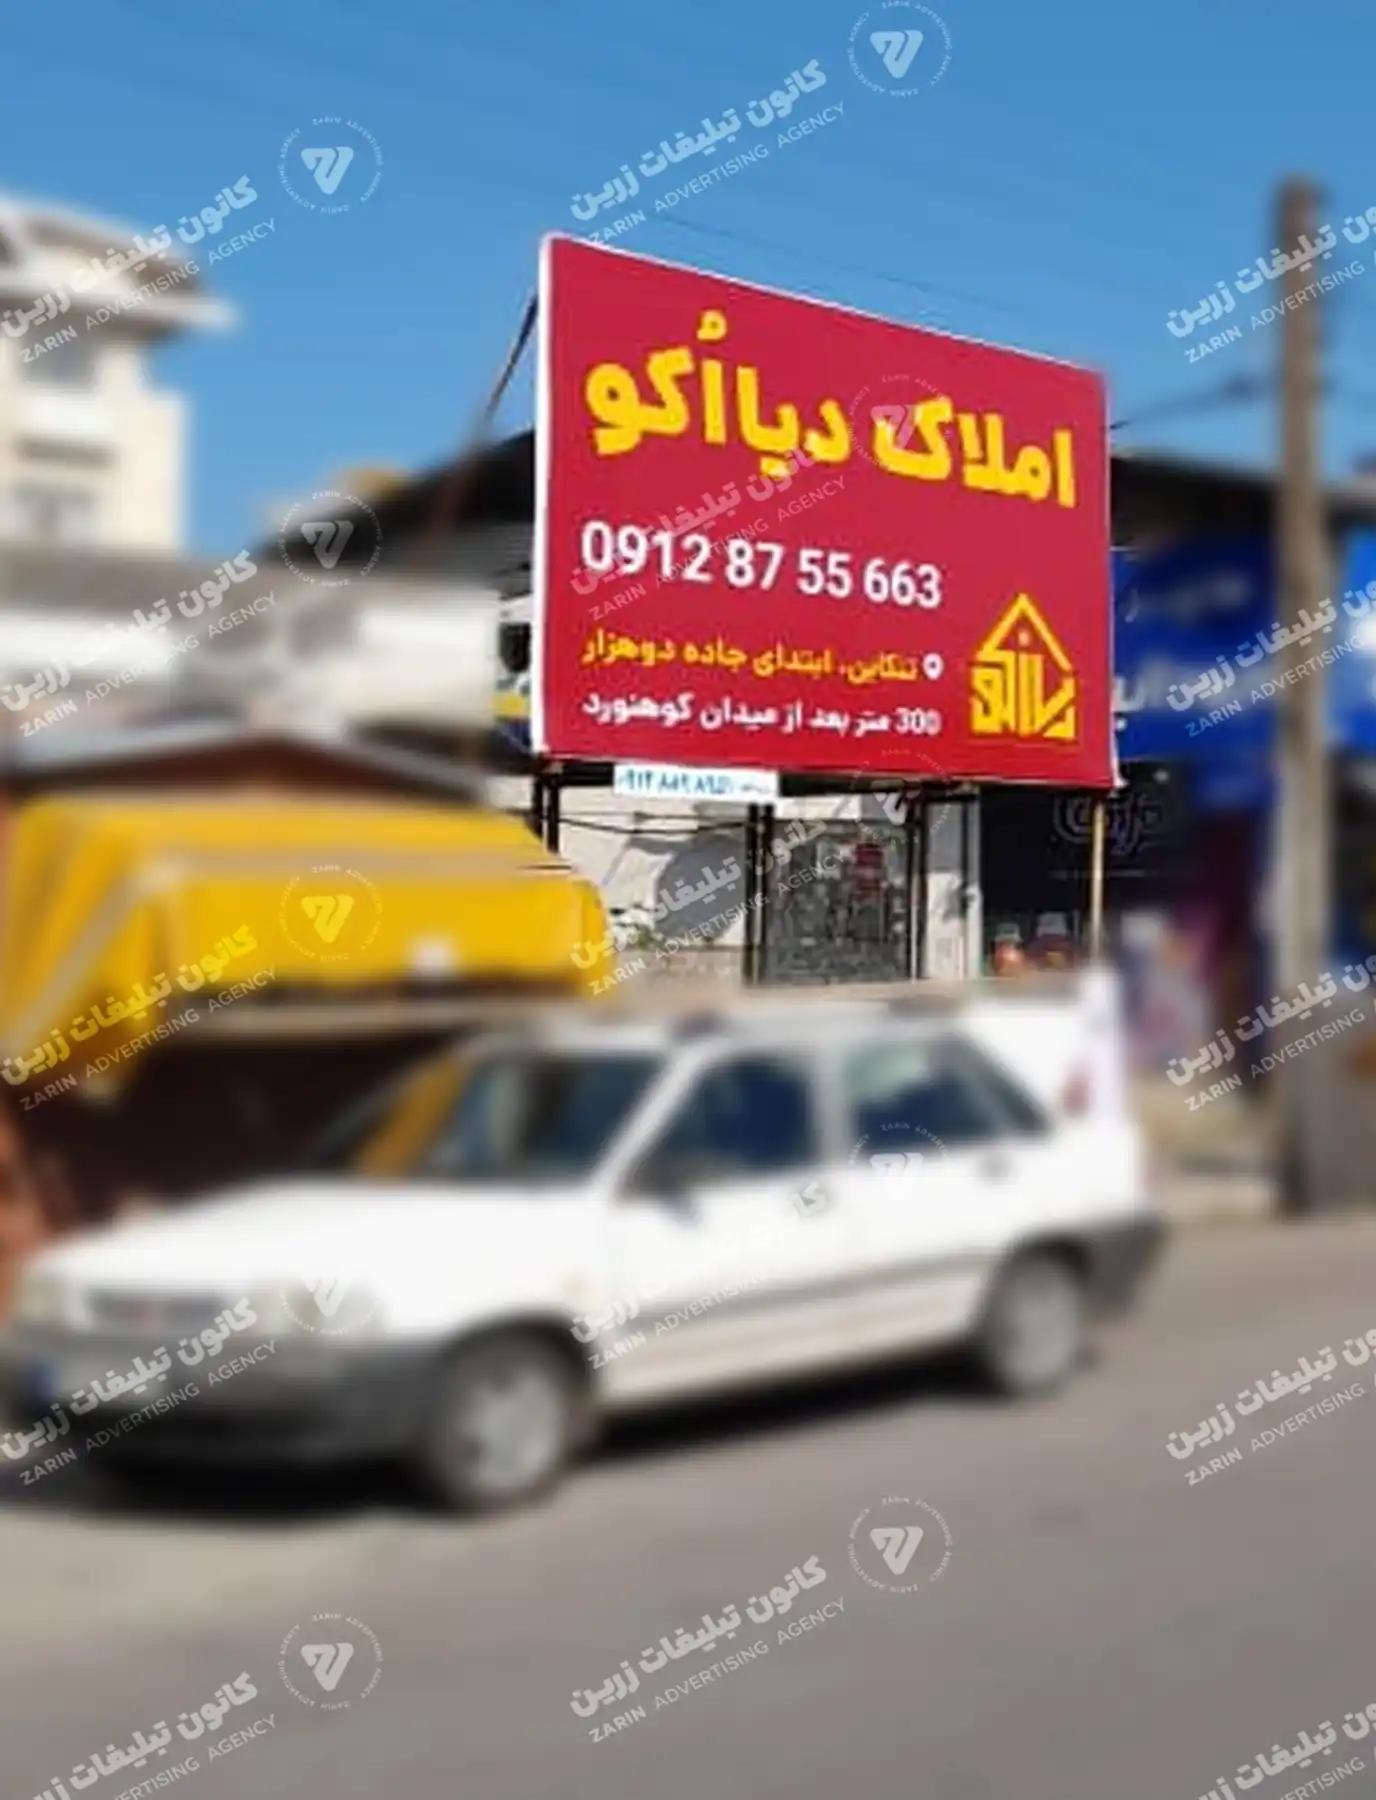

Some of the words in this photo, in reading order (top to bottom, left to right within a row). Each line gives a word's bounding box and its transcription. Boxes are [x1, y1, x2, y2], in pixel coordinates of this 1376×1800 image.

[873, 397, 1077, 508] املاک
[581, 519, 714, 583] 0912
[725, 538, 784, 591] 87
[797, 548, 853, 598] 55
[863, 559, 942, 607] 663
[581, 627, 676, 666] دوهزار
[683, 635, 748, 673] جاده
[754, 642, 833, 680] ابتدای
[581, 690, 694, 727] کوهنورد
[699, 696, 778, 731] میدان
[782, 698, 803, 733] از
[809, 705, 850, 738] بعد
[853, 709, 890, 737] متر
[895, 706, 942, 735] 300
